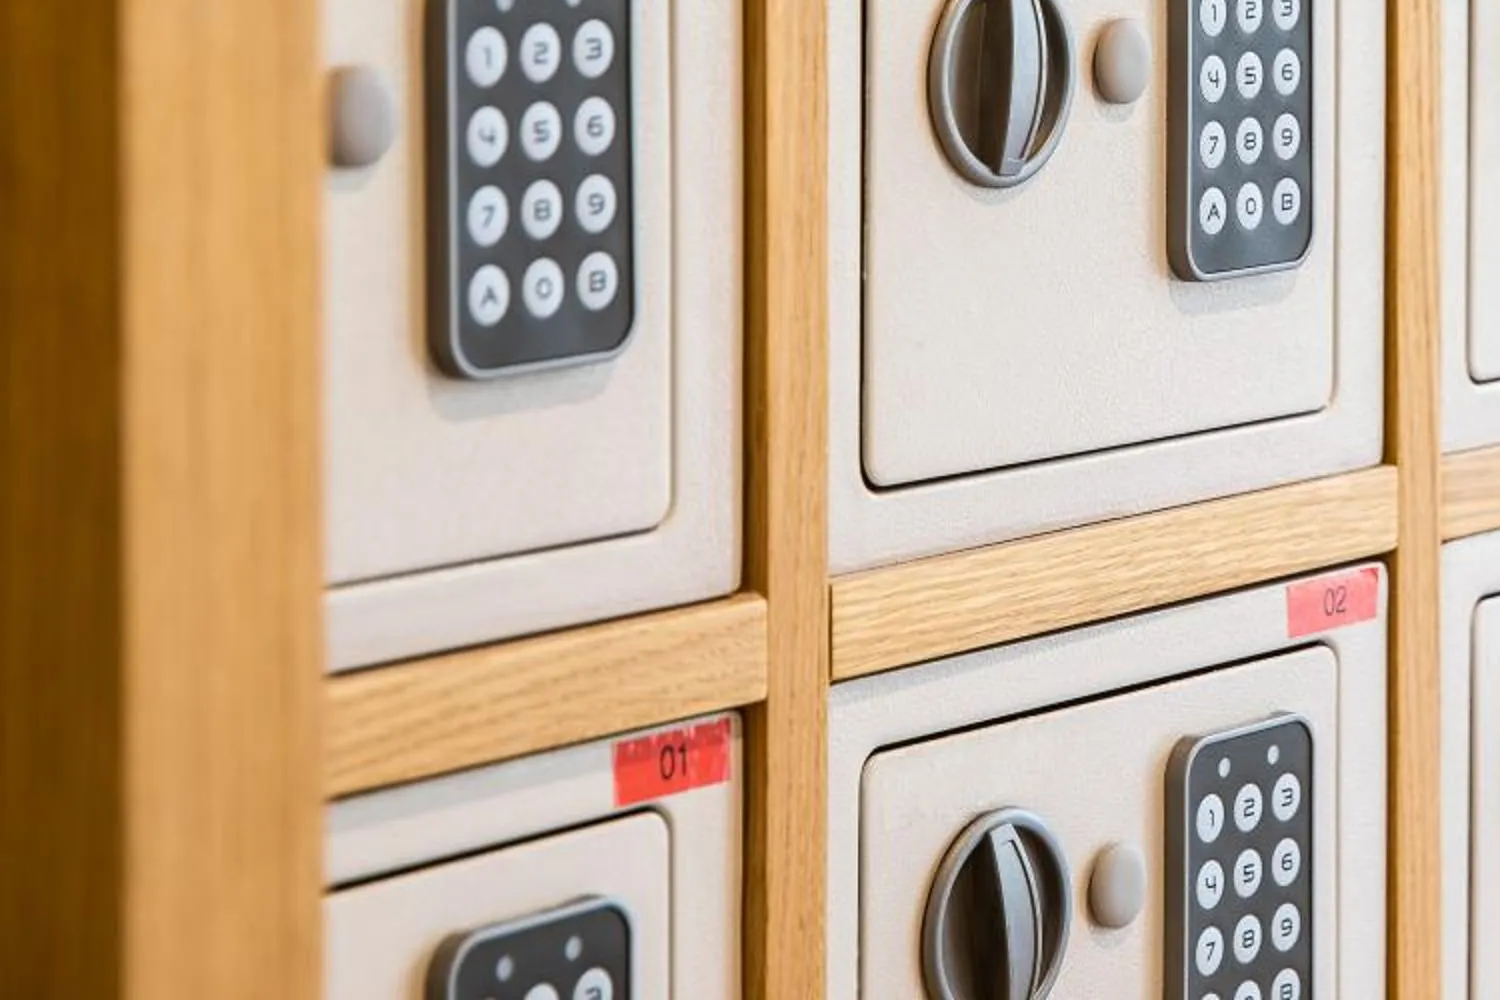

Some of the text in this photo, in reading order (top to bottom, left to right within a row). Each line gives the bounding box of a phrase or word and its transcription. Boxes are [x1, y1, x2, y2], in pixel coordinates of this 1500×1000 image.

[1211, 3, 1217, 23] 1
[1245, 0, 1257, 20] 2
[482, 37, 603, 70] 1 2 3
[1207, 62, 1293, 89] 4 5 6
[478, 114, 604, 148] 4 5 6
[1209, 127, 1294, 155] 7 8 9
[481, 192, 606, 229] 7 8 9
[1206, 202, 1221, 222] A
[1281, 192, 1293, 212] B
[480, 283, 498, 307] A
[588, 270, 607, 294] B
[1323, 585, 1347, 617] 02
[659, 743, 688, 781] 01
[1208, 787, 1294, 828] 1 2 3
[1205, 852, 1293, 896] 4 5 6
[1205, 917, 1293, 962] 7 8 9
